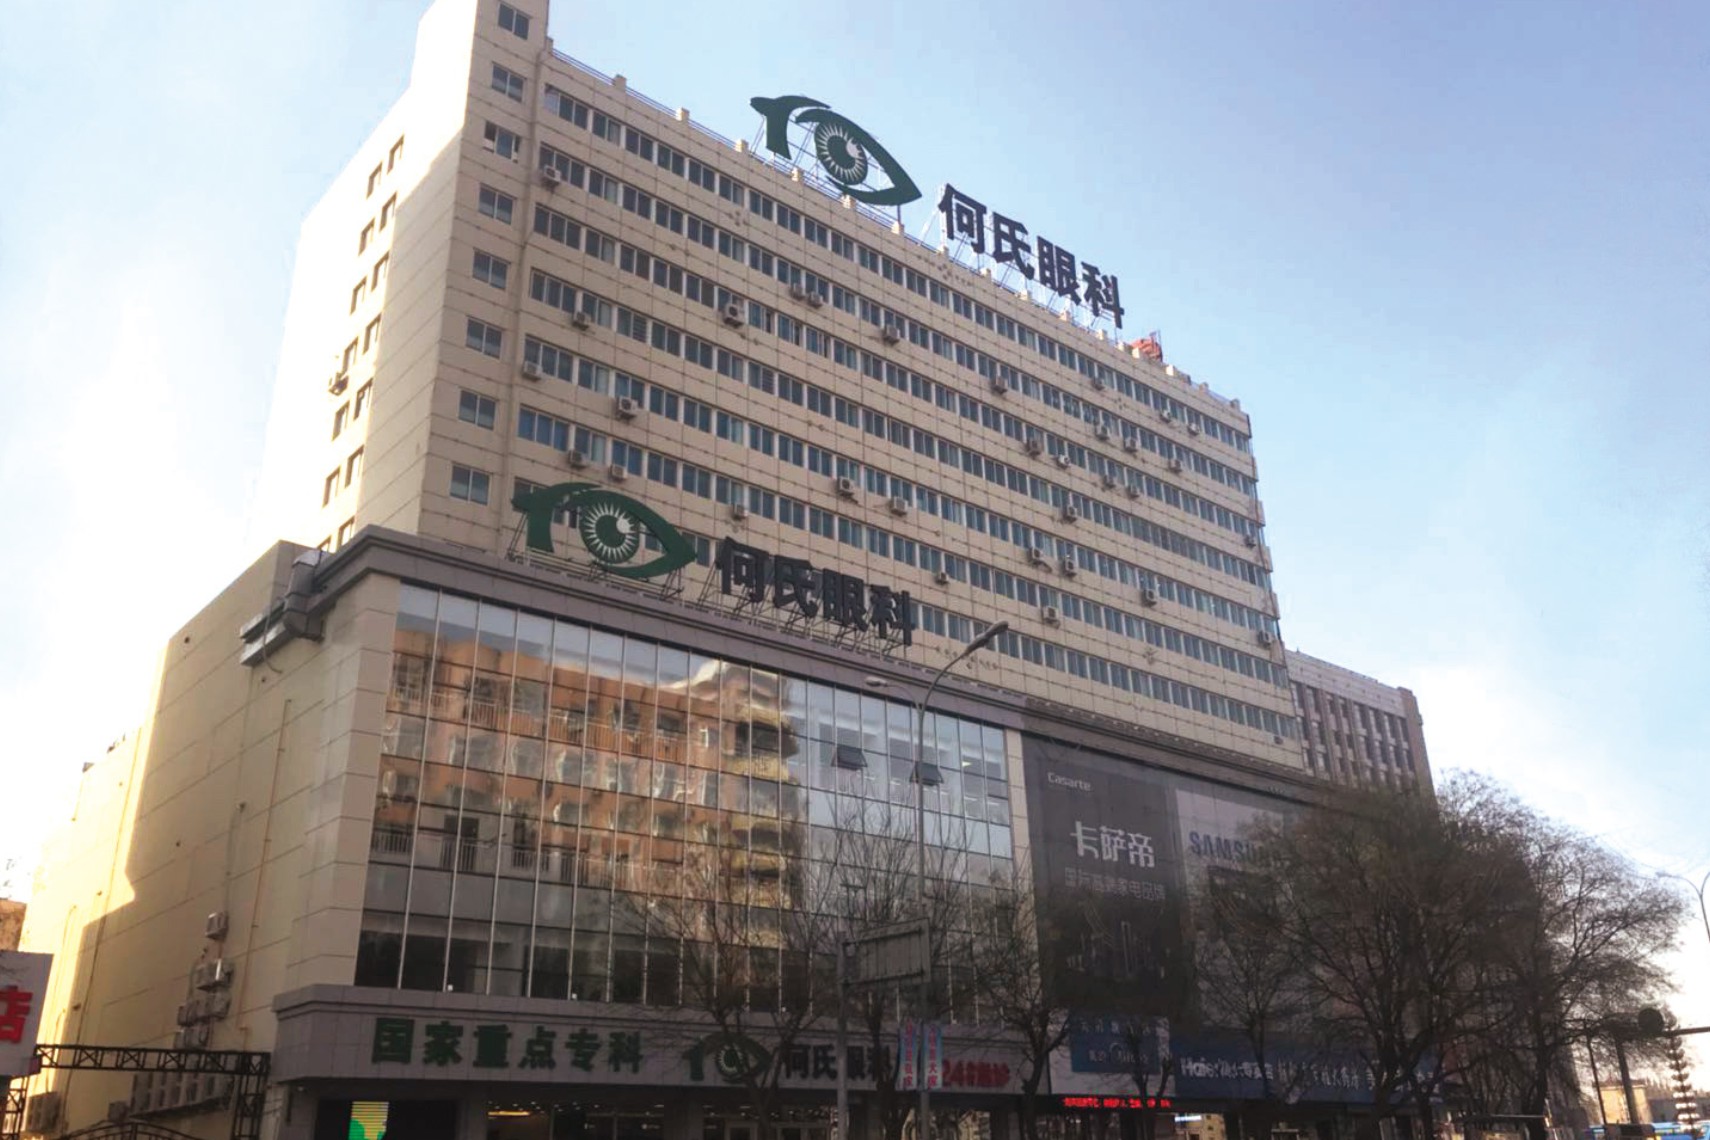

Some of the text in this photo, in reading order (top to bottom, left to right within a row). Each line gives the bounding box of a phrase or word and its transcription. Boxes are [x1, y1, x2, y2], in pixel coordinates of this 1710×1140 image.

[938, 182, 1125, 329] 何氏眼科
[715, 536, 916, 647] 何氏眼科
[1047, 771, 1091, 792] Casarte
[1070, 820, 1155, 868] 卡萨帝
[372, 1016, 642, 1074] 国家重点专科
